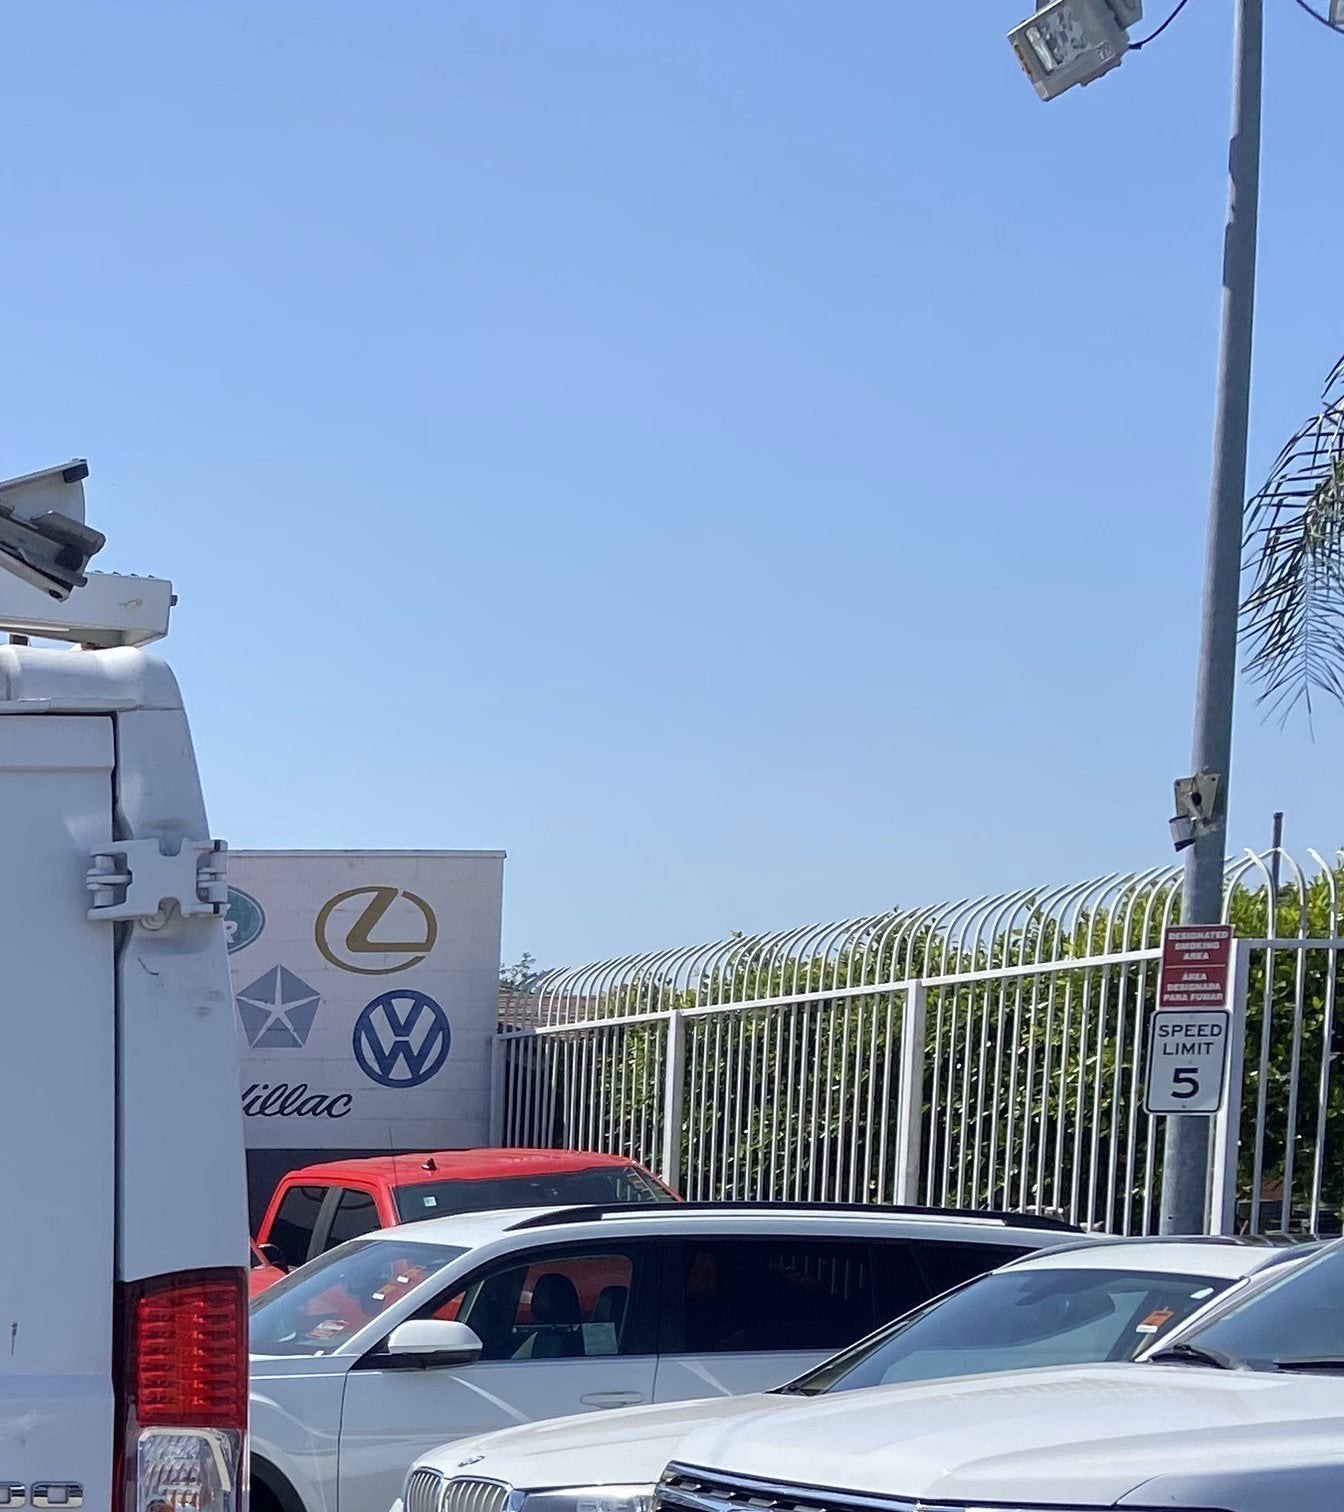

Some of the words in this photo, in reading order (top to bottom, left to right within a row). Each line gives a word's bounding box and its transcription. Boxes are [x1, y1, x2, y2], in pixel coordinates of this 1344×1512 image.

[1182, 951, 1210, 961] AREA
[1157, 1023, 1223, 1038] SPEED
[1162, 1042, 1215, 1056] LIMIT
[1170, 1067, 1200, 1099] 5
[241, 1083, 353, 1119] illac
